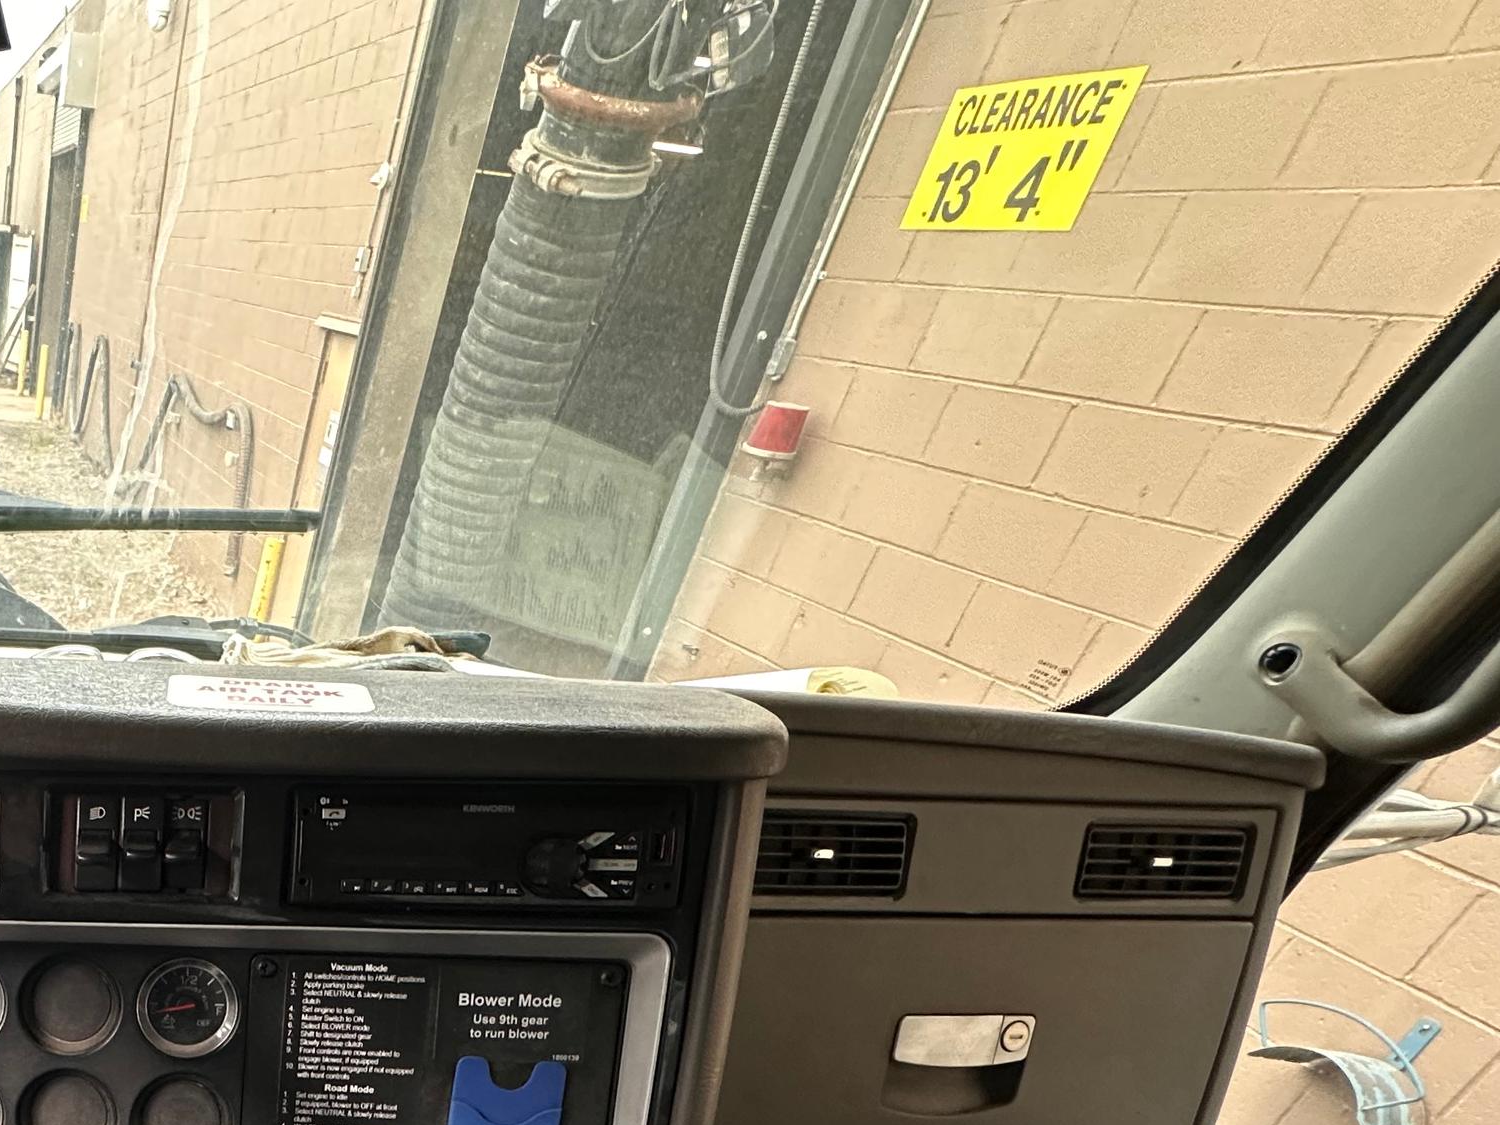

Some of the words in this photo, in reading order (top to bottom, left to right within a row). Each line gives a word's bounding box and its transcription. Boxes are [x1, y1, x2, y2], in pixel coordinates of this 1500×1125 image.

[954, 79, 1124, 137] CLEARANCE
[927, 144, 1002, 223] 13'
[1003, 139, 1089, 222] 4"
[223, 680, 315, 688] DRAIN
[197, 685, 248, 693] AIR
[261, 688, 344, 697] TANK
[227, 695, 315, 704] DAILY
[331, 963, 364, 972] Vacuum
[365, 964, 388, 973] Mode
[181, 975, 198, 985] 1/2
[304, 981, 321, 989] Apply
[322, 981, 345, 990] parking
[303, 989, 323, 997] Select
[324, 990, 356, 998] NEUTRAL
[363, 992, 383, 1000] slowly
[458, 992, 514, 1007] Blower
[518, 994, 562, 1008] Mode
[216, 1007, 222, 1016] F
[301, 1013, 322, 1021] Master
[324, 1014, 345, 1022] Switch
[473, 1014, 496, 1025] Use
[499, 1014, 518, 1025] 9th
[521, 1016, 549, 1028] gear
[301, 1022, 320, 1030] Select
[352, 1024, 370, 1032] mode
[323, 1032, 357, 1040] designated
[358, 1033, 372, 1041] gear
[470, 1029, 482, 1039] to
[484, 1030, 505, 1039] run
[508, 1029, 550, 1040] blower
[300, 1038, 320, 1047] Slowly
[324, 1083, 347, 1092] Road
[350, 1084, 374, 1094] Mode
[296, 1091, 306, 1099] Set
